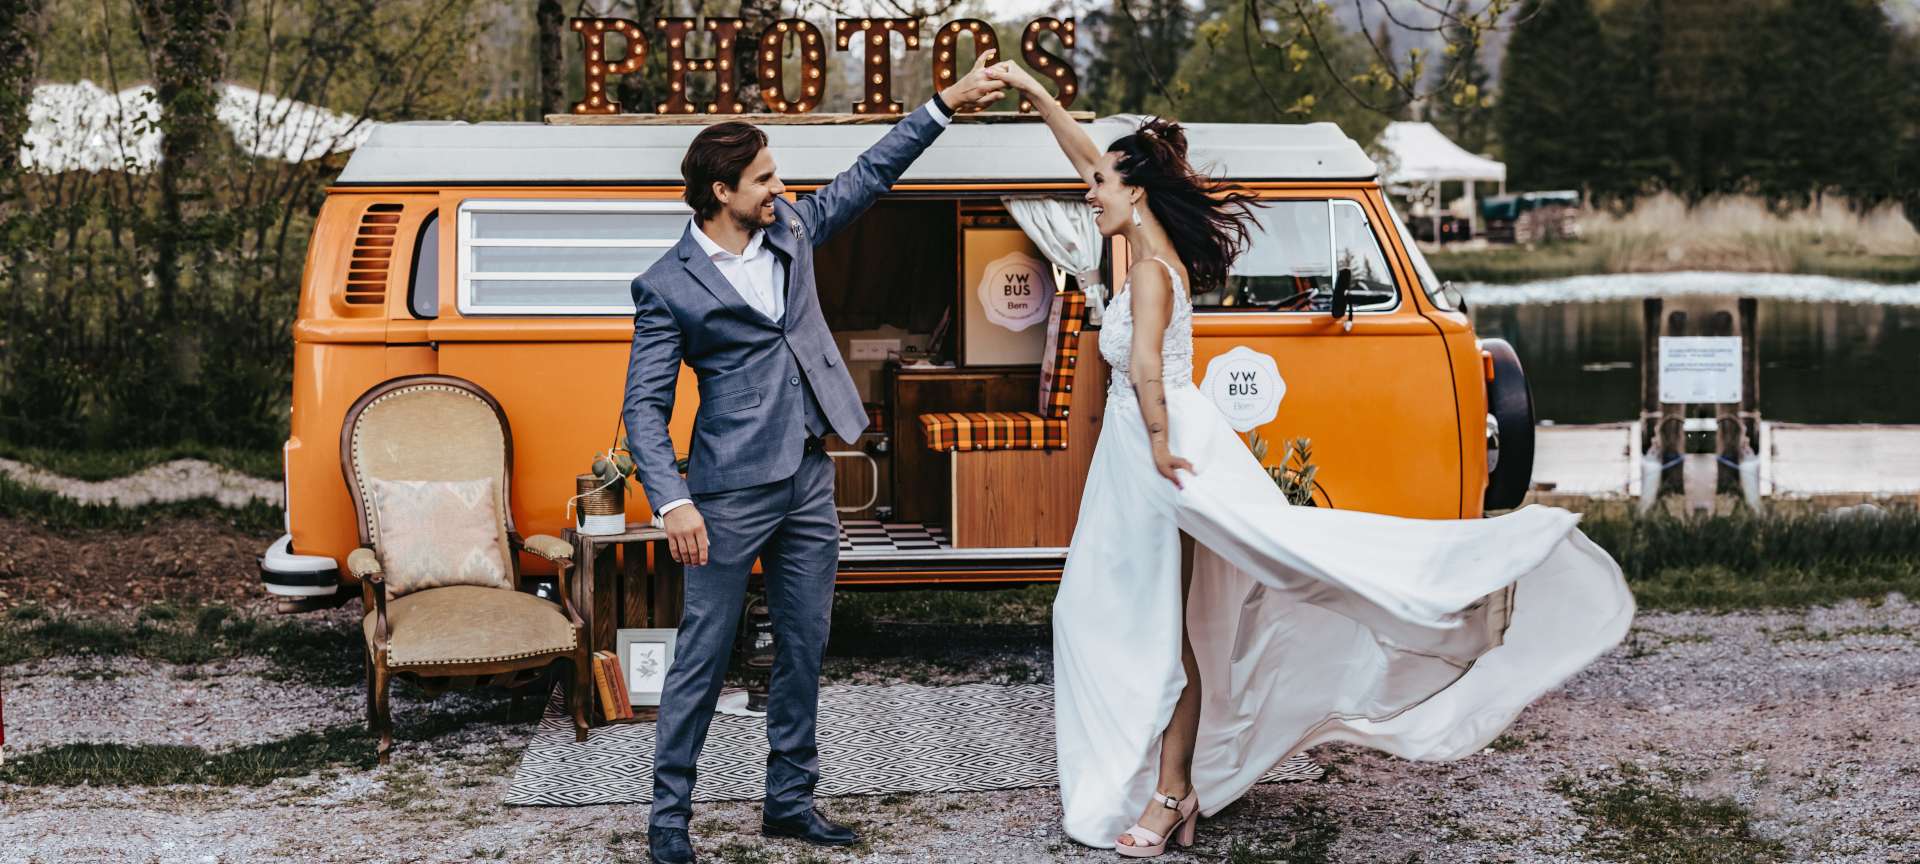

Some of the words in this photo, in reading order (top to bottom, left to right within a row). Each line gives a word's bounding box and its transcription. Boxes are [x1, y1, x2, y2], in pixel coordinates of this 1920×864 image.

[570, 17, 1078, 114] PHOTOS
[1005, 273, 1030, 283] VW
[1004, 285, 1031, 296] BUS
[1007, 301, 1028, 310] Bern
[1230, 371, 1256, 382] VW
[1229, 383, 1258, 396] BUS
